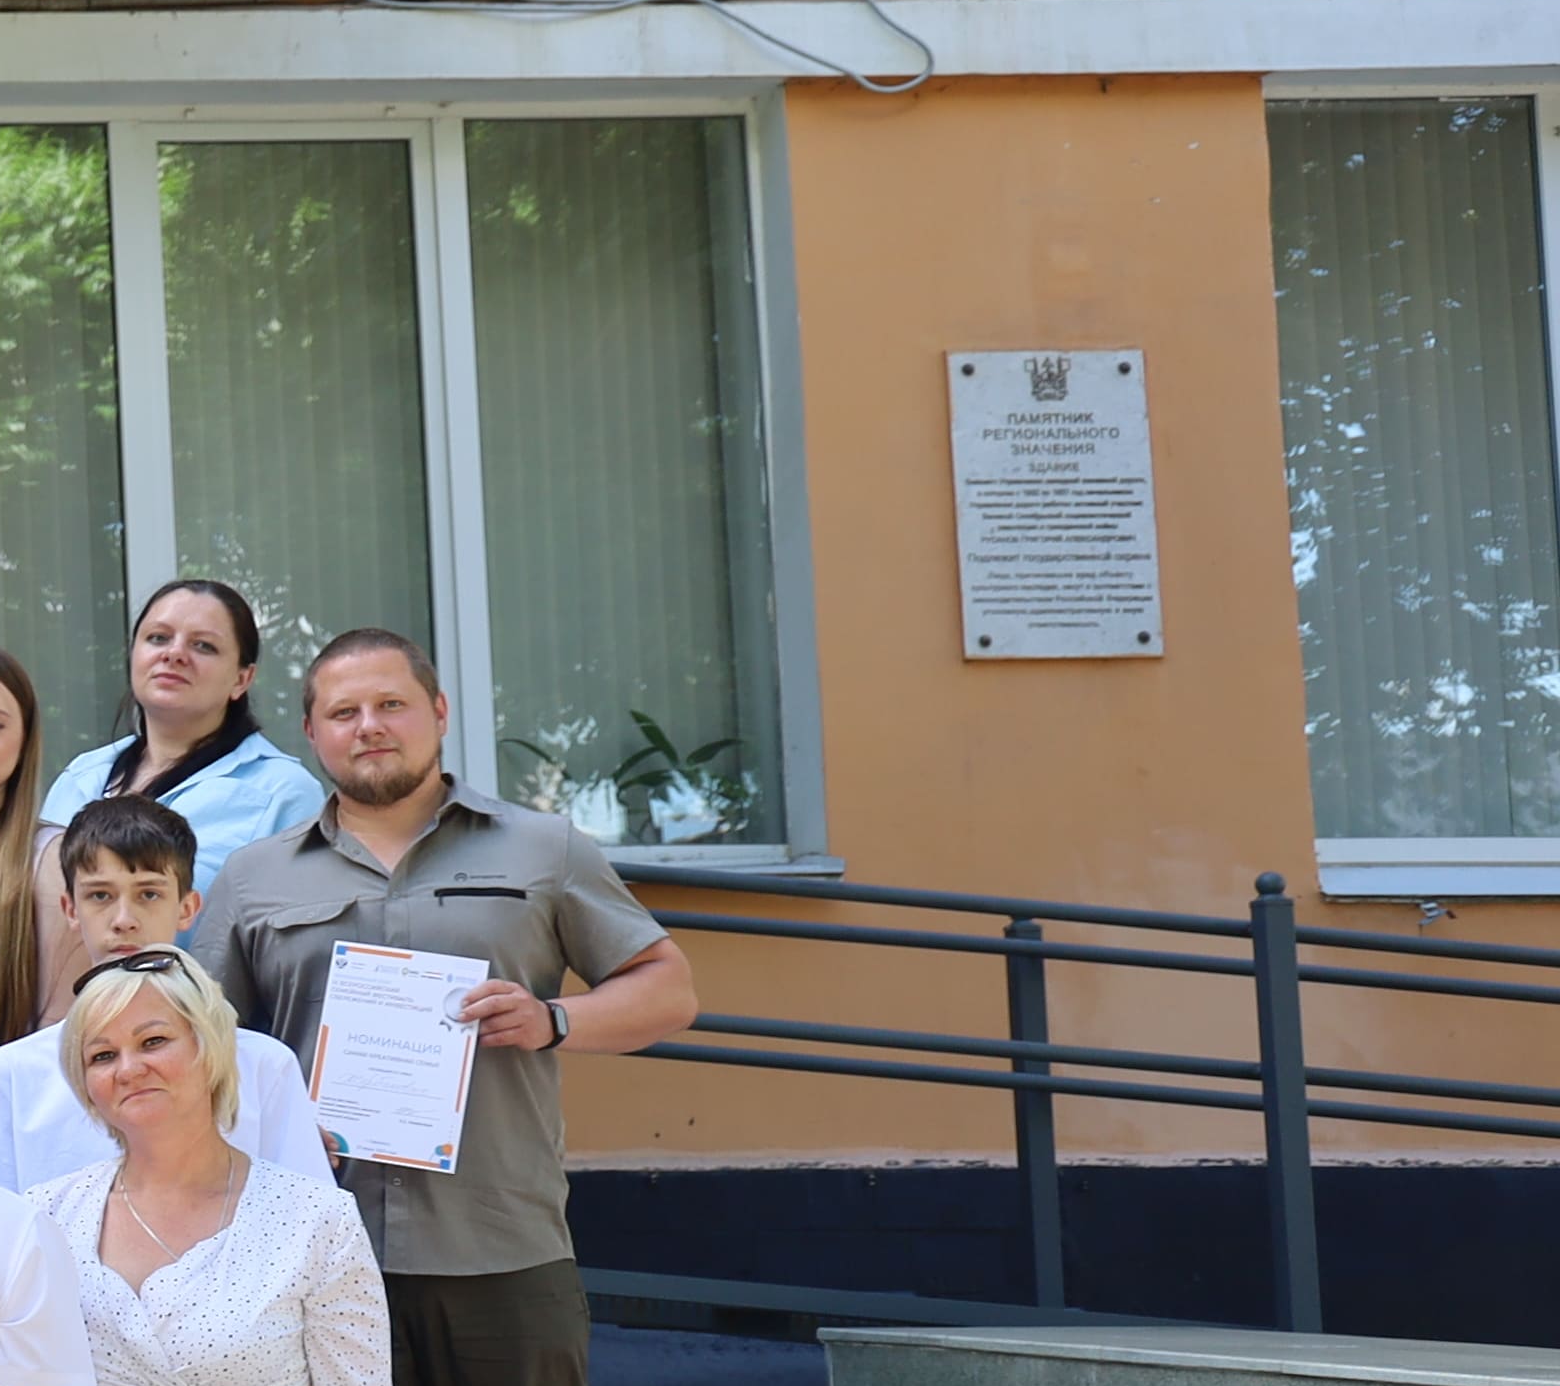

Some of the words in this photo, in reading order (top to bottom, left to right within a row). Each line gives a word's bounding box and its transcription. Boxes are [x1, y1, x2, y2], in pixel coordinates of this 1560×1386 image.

[1007, 412, 1095, 425] ПАМЯТНИК
[982, 427, 1121, 441] РЕГИОНАЛЬНОГО
[1010, 443, 1096, 456] ЗНАЧЕНИЯ
[347, 1031, 443, 1055] НОМИНАЦИЯ
